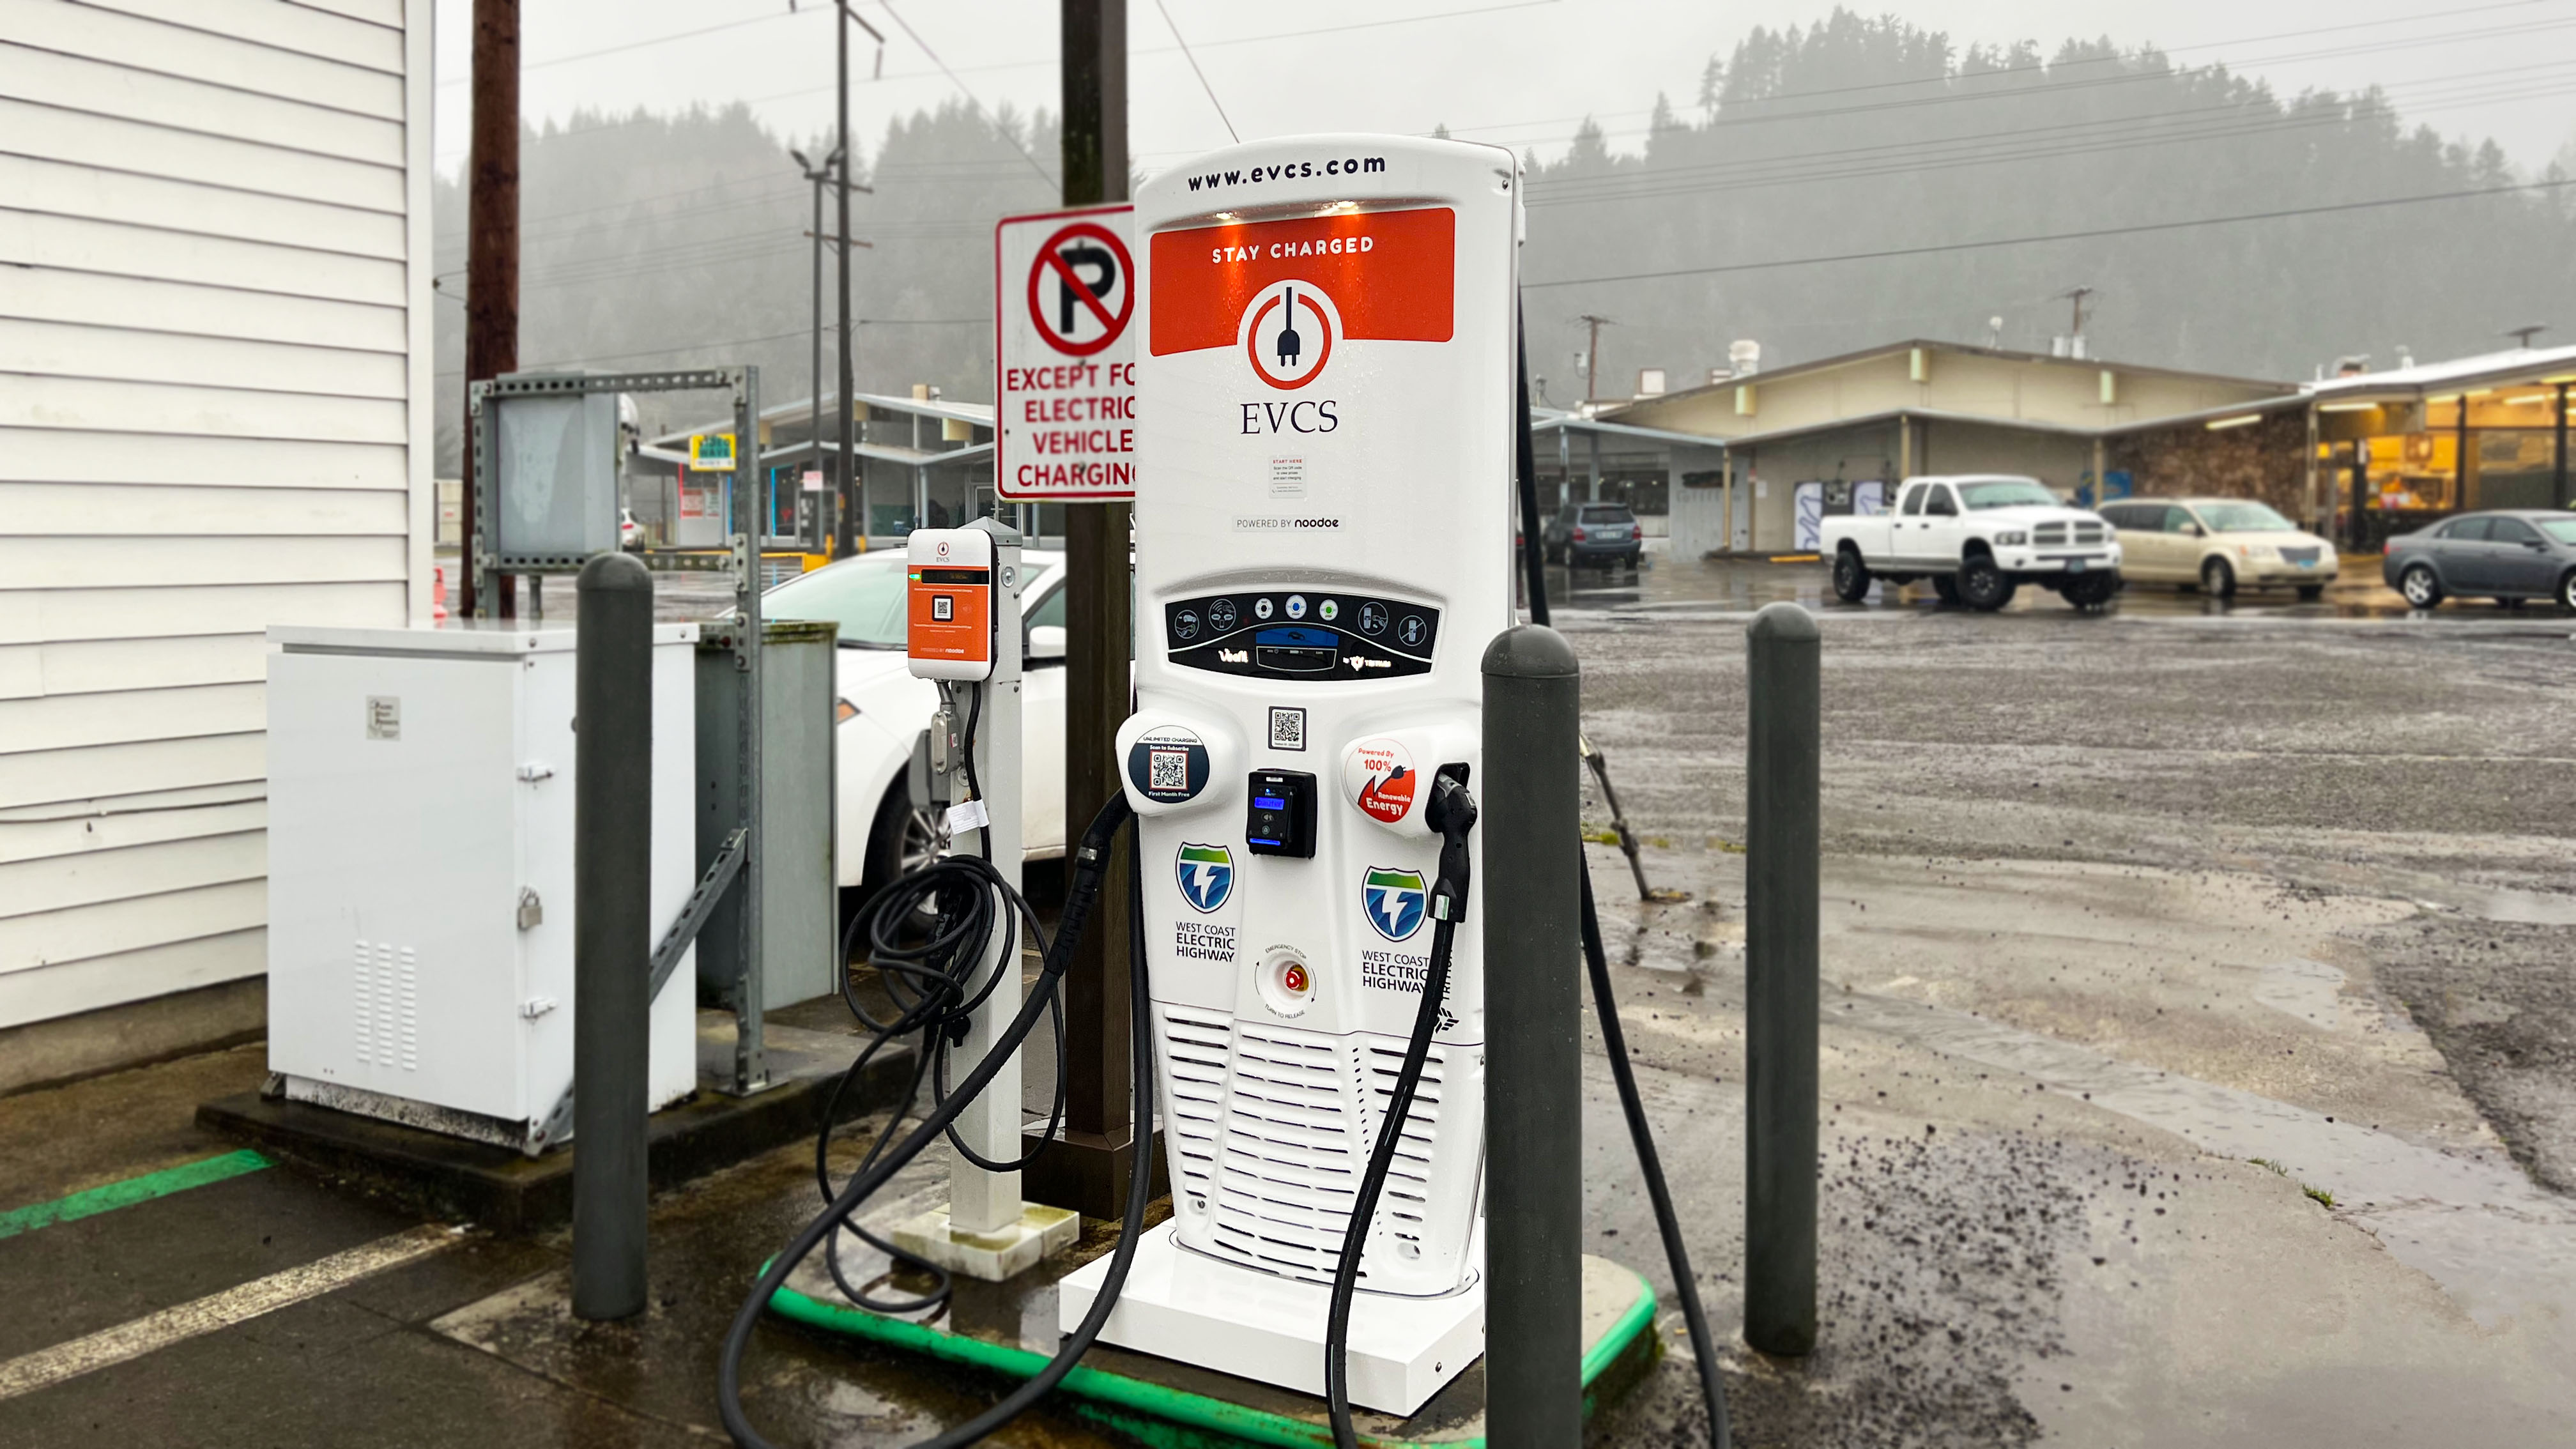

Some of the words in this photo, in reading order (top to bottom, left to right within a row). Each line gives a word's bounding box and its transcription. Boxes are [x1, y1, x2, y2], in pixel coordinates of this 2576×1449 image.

[1188, 155, 1386, 192] www.evcs.com
[1212, 245, 1259, 264] STAY
[1270, 236, 1374, 257] CHARGED
[1007, 364, 1100, 392] EXCEPT
[1110, 362, 1135, 387] FO
[1025, 395, 1135, 422] ELECTRIC
[1240, 400, 1338, 434] EVCS
[1032, 429, 1133, 454] VEHICLE
[1018, 462, 1135, 487] CHARGIN
[1237, 519, 1278, 528] POWERED
[1280, 519, 1291, 528] BY
[1294, 518, 1339, 528] noodoe
[1358, 747, 1384, 756] Powered
[1364, 758, 1392, 772] 100%
[1378, 792, 1411, 802] Renewable
[1366, 797, 1403, 816] Energy
[1176, 921, 1202, 933] WEST
[1204, 924, 1236, 937] COAST
[1176, 932, 1235, 950] ELECTRIC
[1176, 945, 1235, 962] HIGHWAY
[1265, 944, 1294, 953] EMERGENCY
[1294, 948, 1307, 959] STOP
[1362, 949, 1391, 963] WEST
[1394, 954, 1430, 967] COAST
[1363, 962, 1429, 981] ELECTRIC
[1265, 1004, 1277, 1015] TURN
[1285, 1009, 1305, 1018] RELEASE
